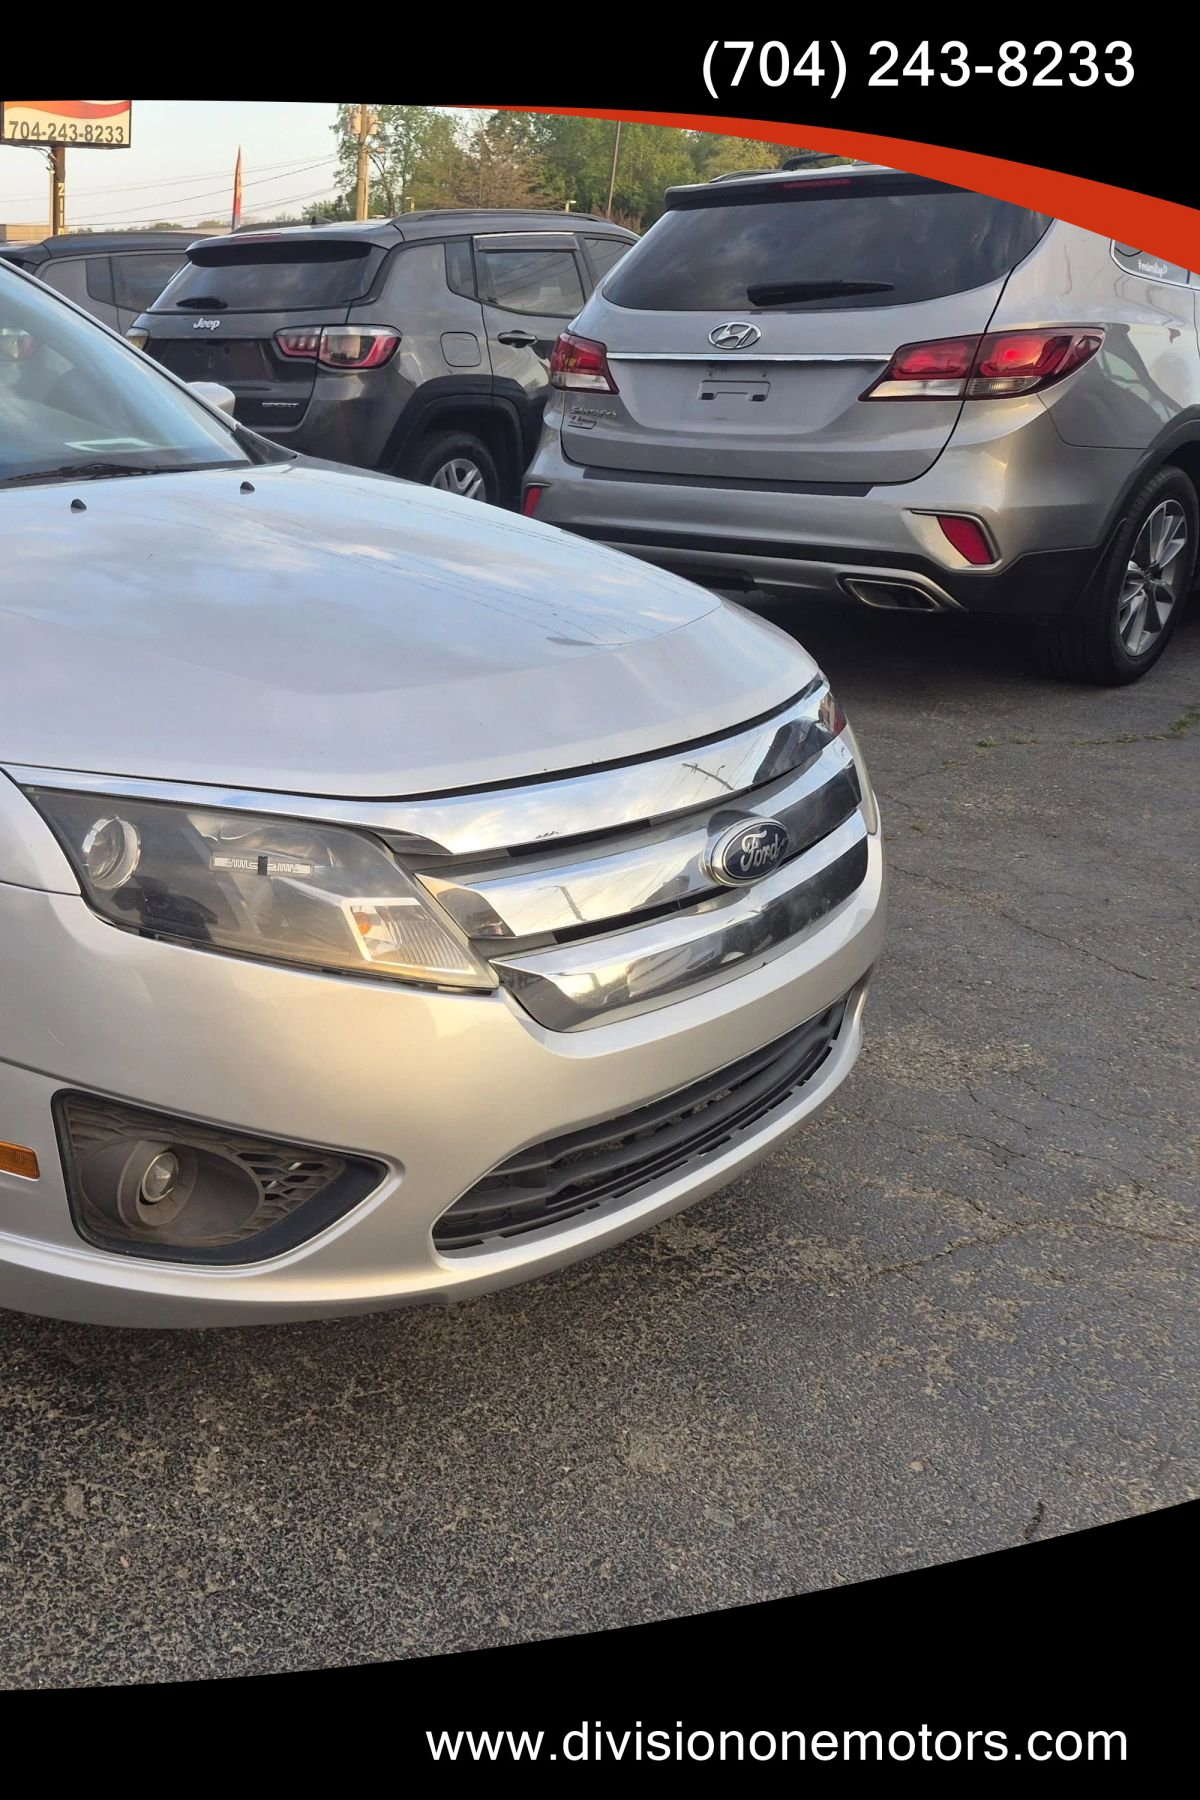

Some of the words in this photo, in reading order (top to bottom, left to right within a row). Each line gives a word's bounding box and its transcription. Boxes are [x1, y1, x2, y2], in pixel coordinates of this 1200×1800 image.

[9, 120, 124, 144] 704-243-8233
[193, 317, 220, 330] Jeep
[740, 829, 787, 872] Ford
